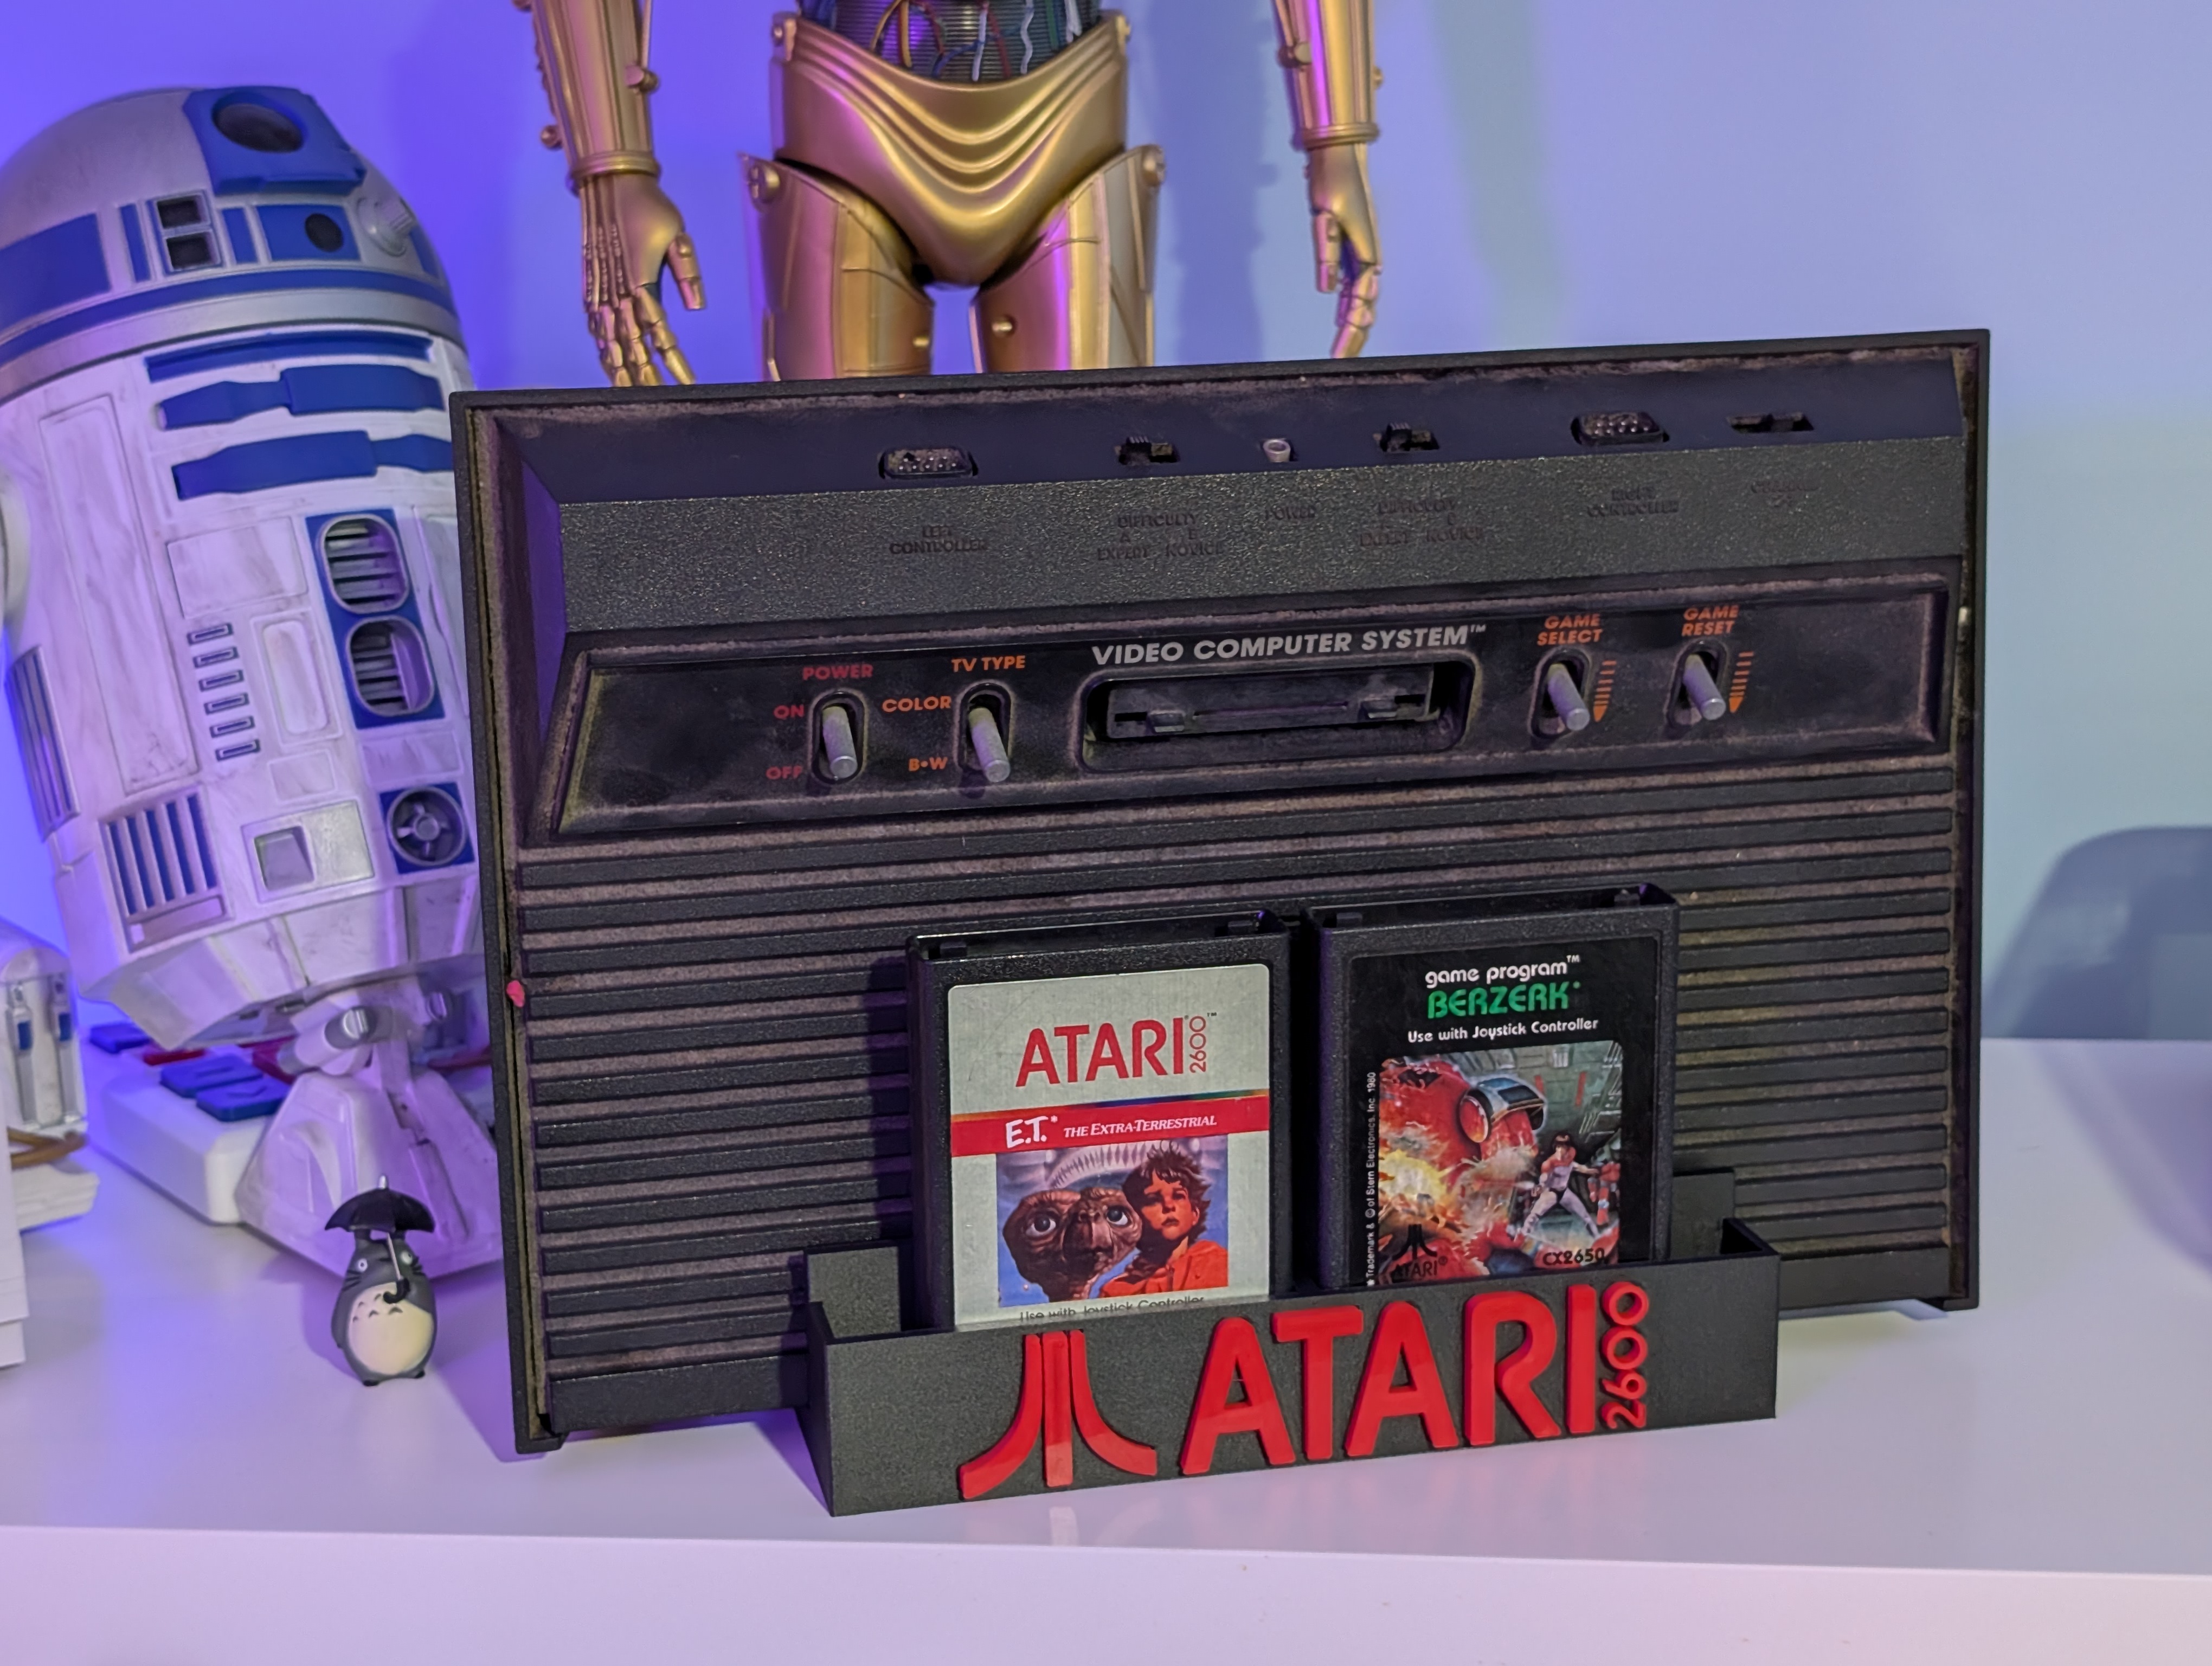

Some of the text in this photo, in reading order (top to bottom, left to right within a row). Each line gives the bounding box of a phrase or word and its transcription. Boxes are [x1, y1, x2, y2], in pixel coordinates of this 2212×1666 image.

[889, 539, 988, 554] CONTROLLER
[1544, 613, 1600, 630] GAME
[1683, 605, 1739, 621] GAME
[1536, 629, 1603, 646] SELECT
[1681, 620, 1735, 637] RESET
[1092, 642, 1184, 665] VIDEO
[1193, 632, 1352, 660] COMPUTER
[802, 664, 873, 681] POWER
[951, 655, 1026, 672] TV TYPE
[773, 706, 805, 719] ON
[882, 696, 952, 712] COLOR
[766, 766, 803, 780] OFF
[1425, 967, 1480, 989] game
[1427, 981, 1571, 1020] BERZERK
[1409, 1017, 1599, 1043] Use with Joystick Controller
[1015, 1017, 1184, 1087] ATARI
[1189, 1015, 1207, 1073] 2600
[1366, 1072, 1376, 1092] 1980
[1063, 1126, 1089, 1138] THE
[1366, 1171, 1375, 1195] Stern
[1366, 1197, 1375, 1207] of
[1366, 1232, 1375, 1277] Trademark
[1543, 1247, 1604, 1266] CX2650
[1391, 1260, 1438, 1279] ATARI
[1602, 1281, 1650, 1430] 2600
[1182, 1284, 1597, 1476] ATARI
